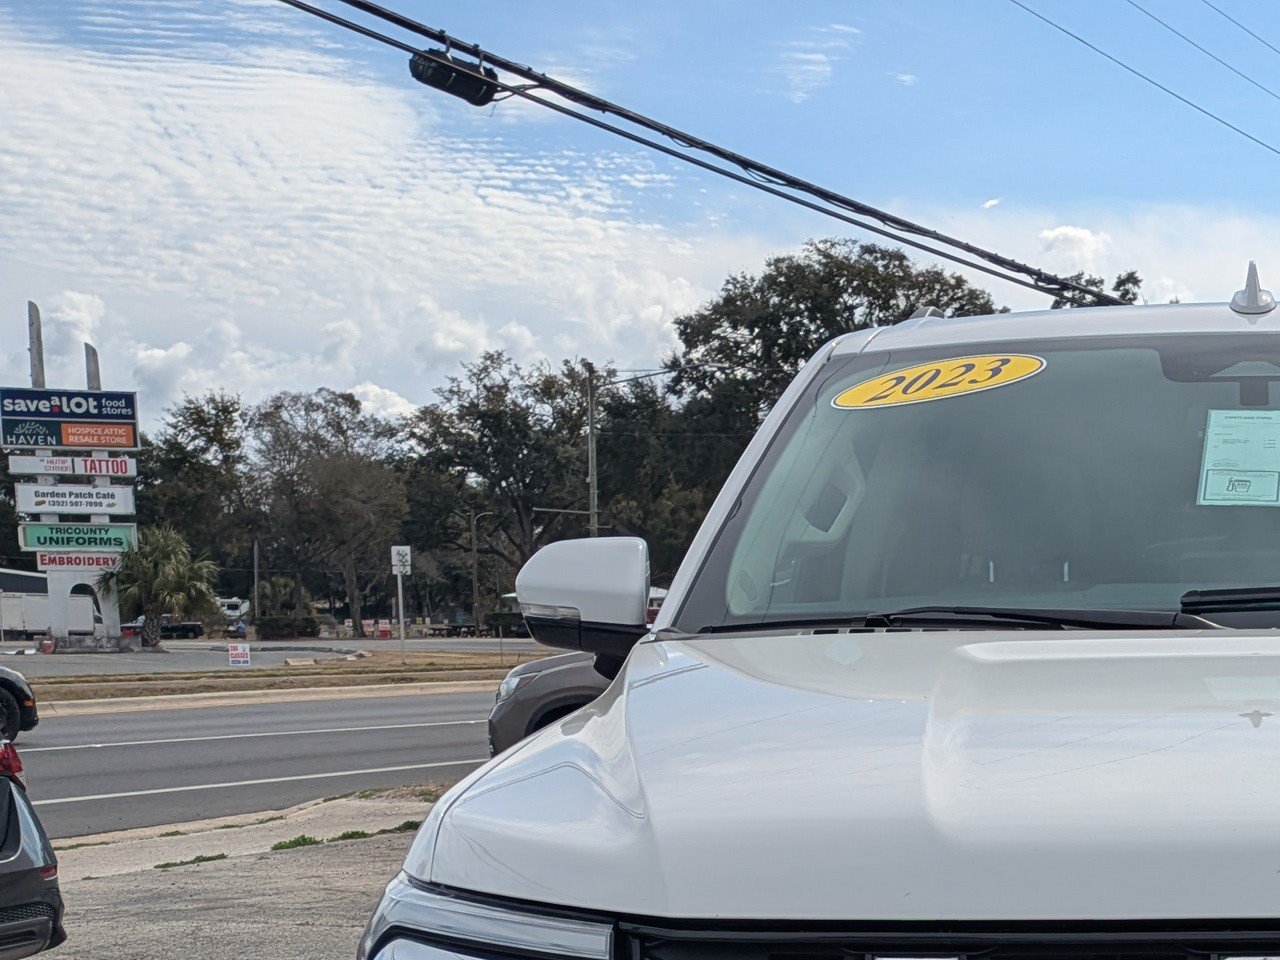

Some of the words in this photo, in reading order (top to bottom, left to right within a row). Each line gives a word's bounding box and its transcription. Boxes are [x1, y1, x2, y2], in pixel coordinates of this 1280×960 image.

[862, 358, 1012, 404] 2023
[3, 398, 51, 413] save
[101, 398, 126, 407] food
[101, 407, 133, 415] stores
[68, 427, 103, 435] HOSPICE
[103, 428, 127, 436] ATTIC
[7, 435, 56, 445] HAVEN
[68, 435, 99, 443] RESALE
[100, 436, 127, 444] STORE
[81, 458, 128, 475] TATTOO
[34, 490, 67, 499] Garden
[68, 491, 94, 500] Patch
[48, 527, 110, 536] TRICOUNTY
[36, 536, 124, 547] UNIFORMS
[39, 553, 118, 567] EMBROIDERY
